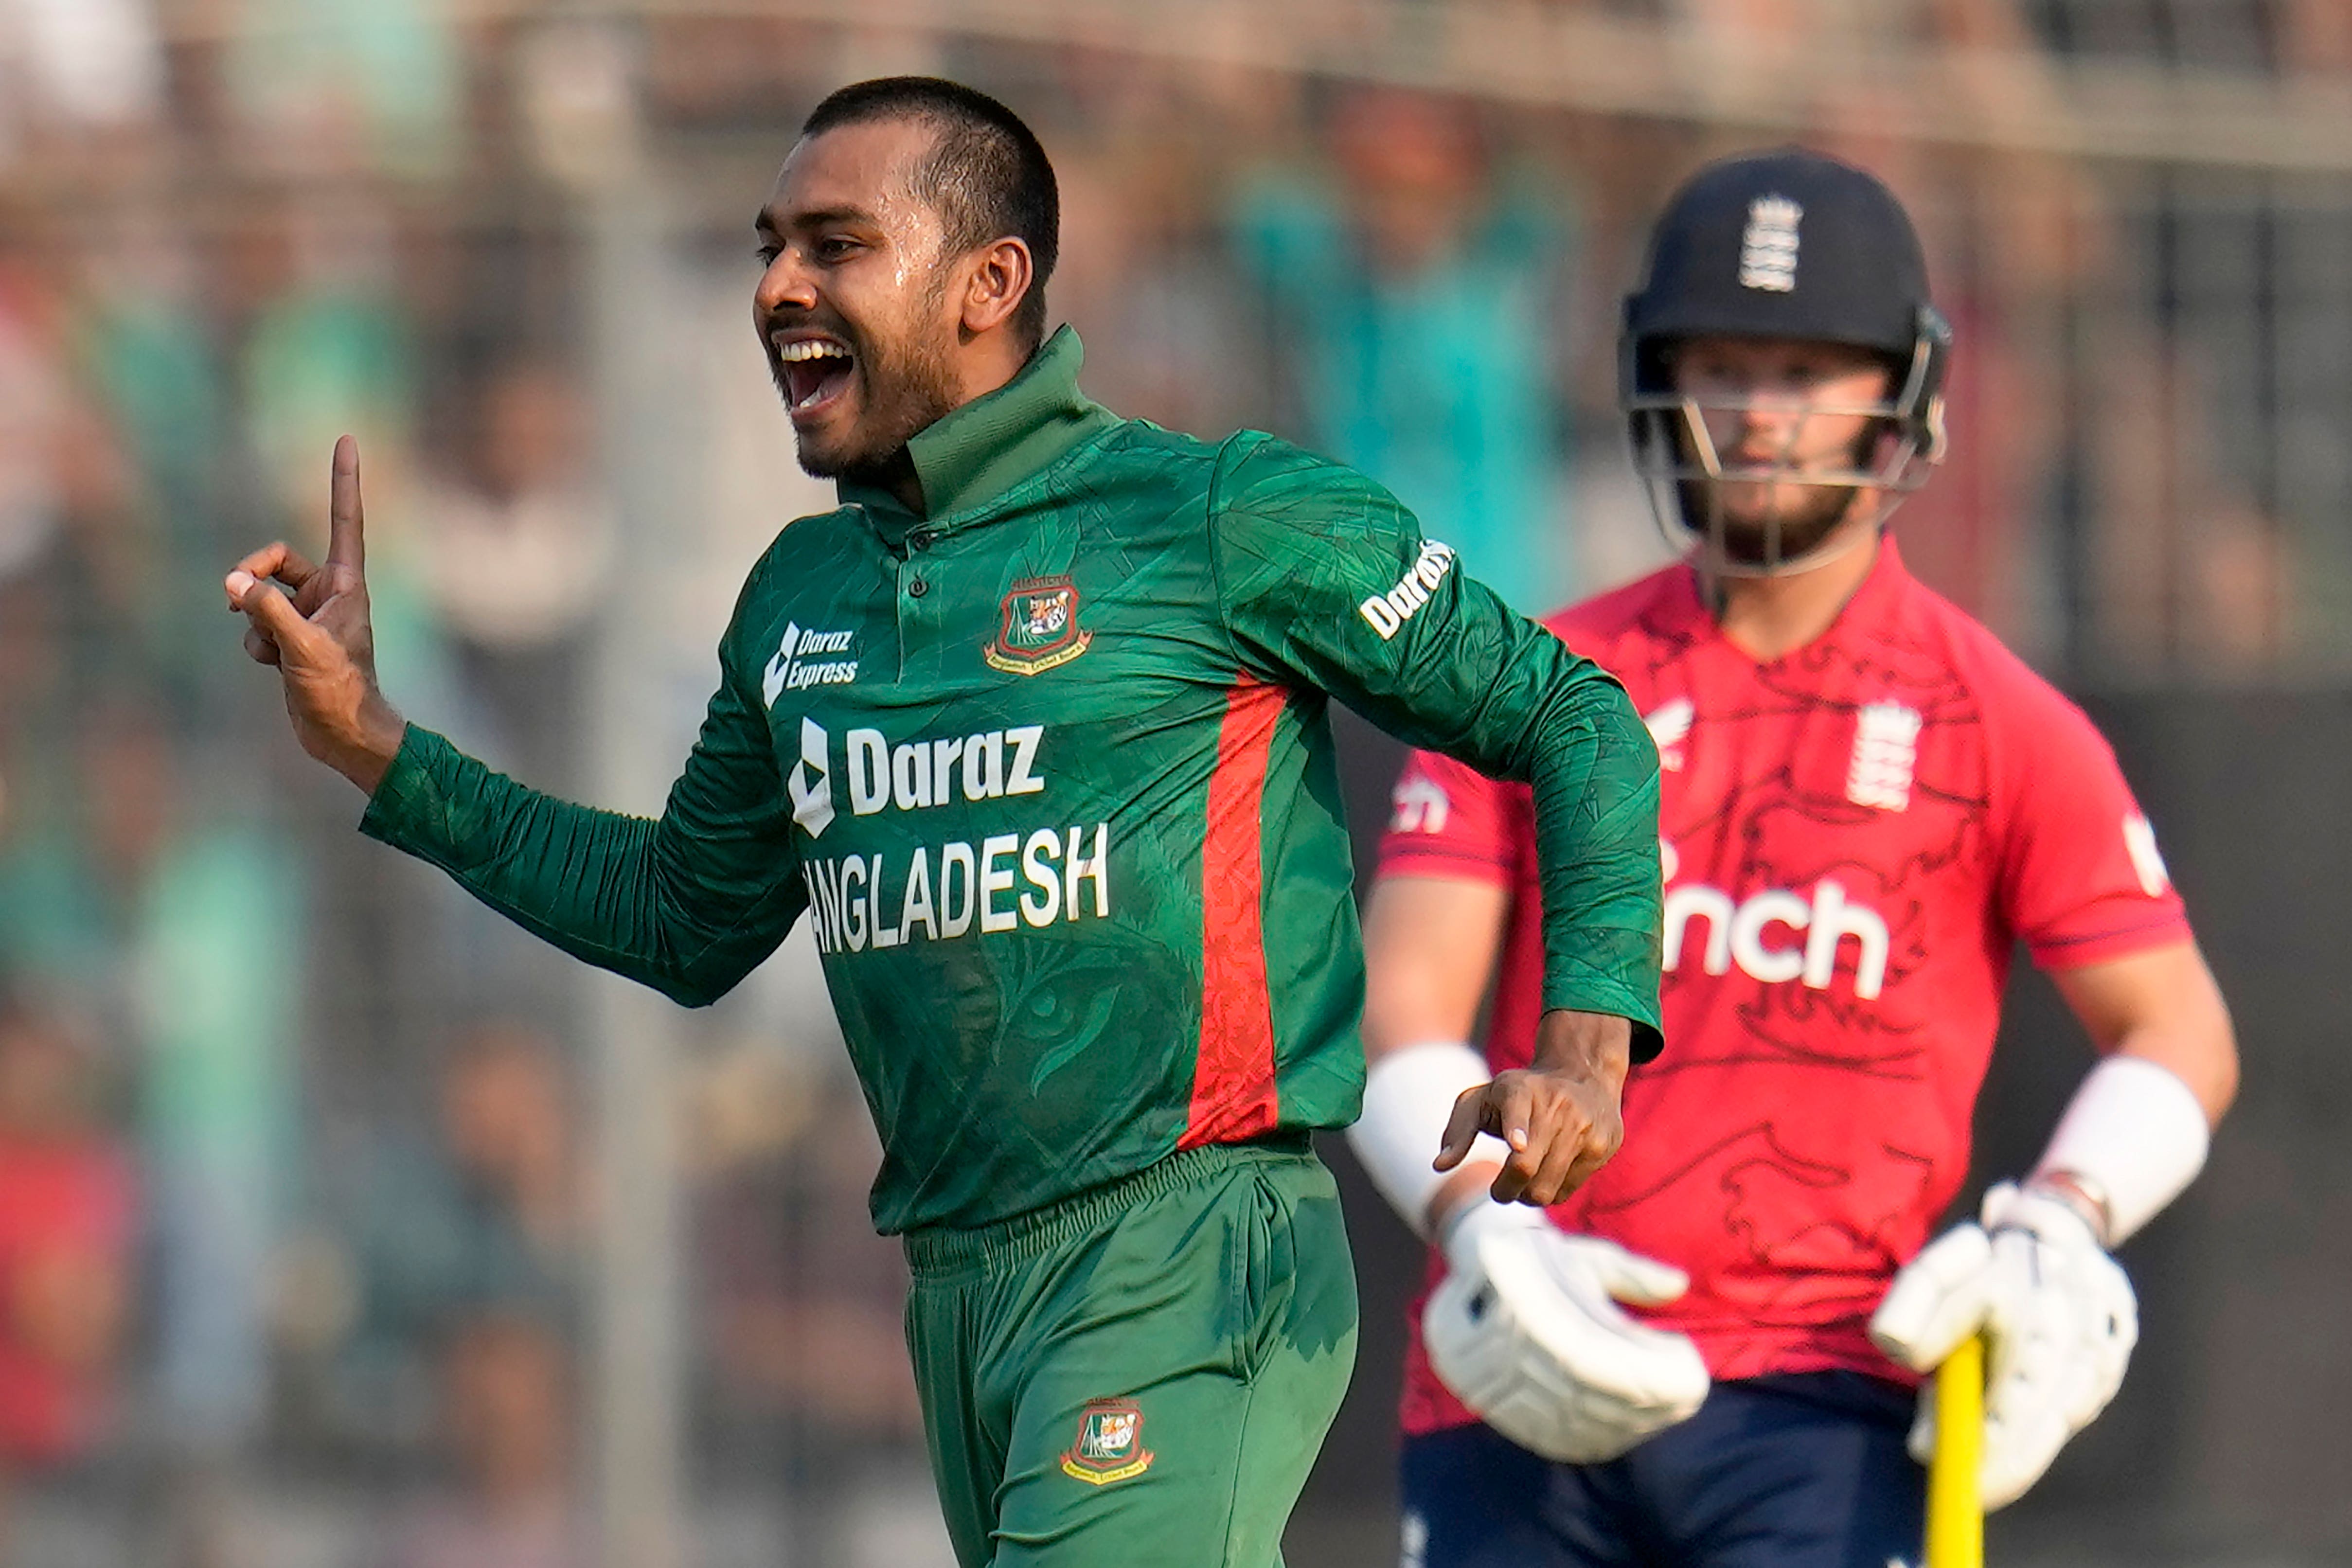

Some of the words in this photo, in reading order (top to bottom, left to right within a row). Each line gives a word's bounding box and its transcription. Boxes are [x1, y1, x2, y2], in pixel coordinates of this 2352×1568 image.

[786, 660, 858, 691] Express
[796, 628, 853, 656] Daraz
[846, 725, 1045, 816] Daraz
[802, 822, 1109, 953] ANGLADESH
[1661, 840, 1890, 1001] nch
